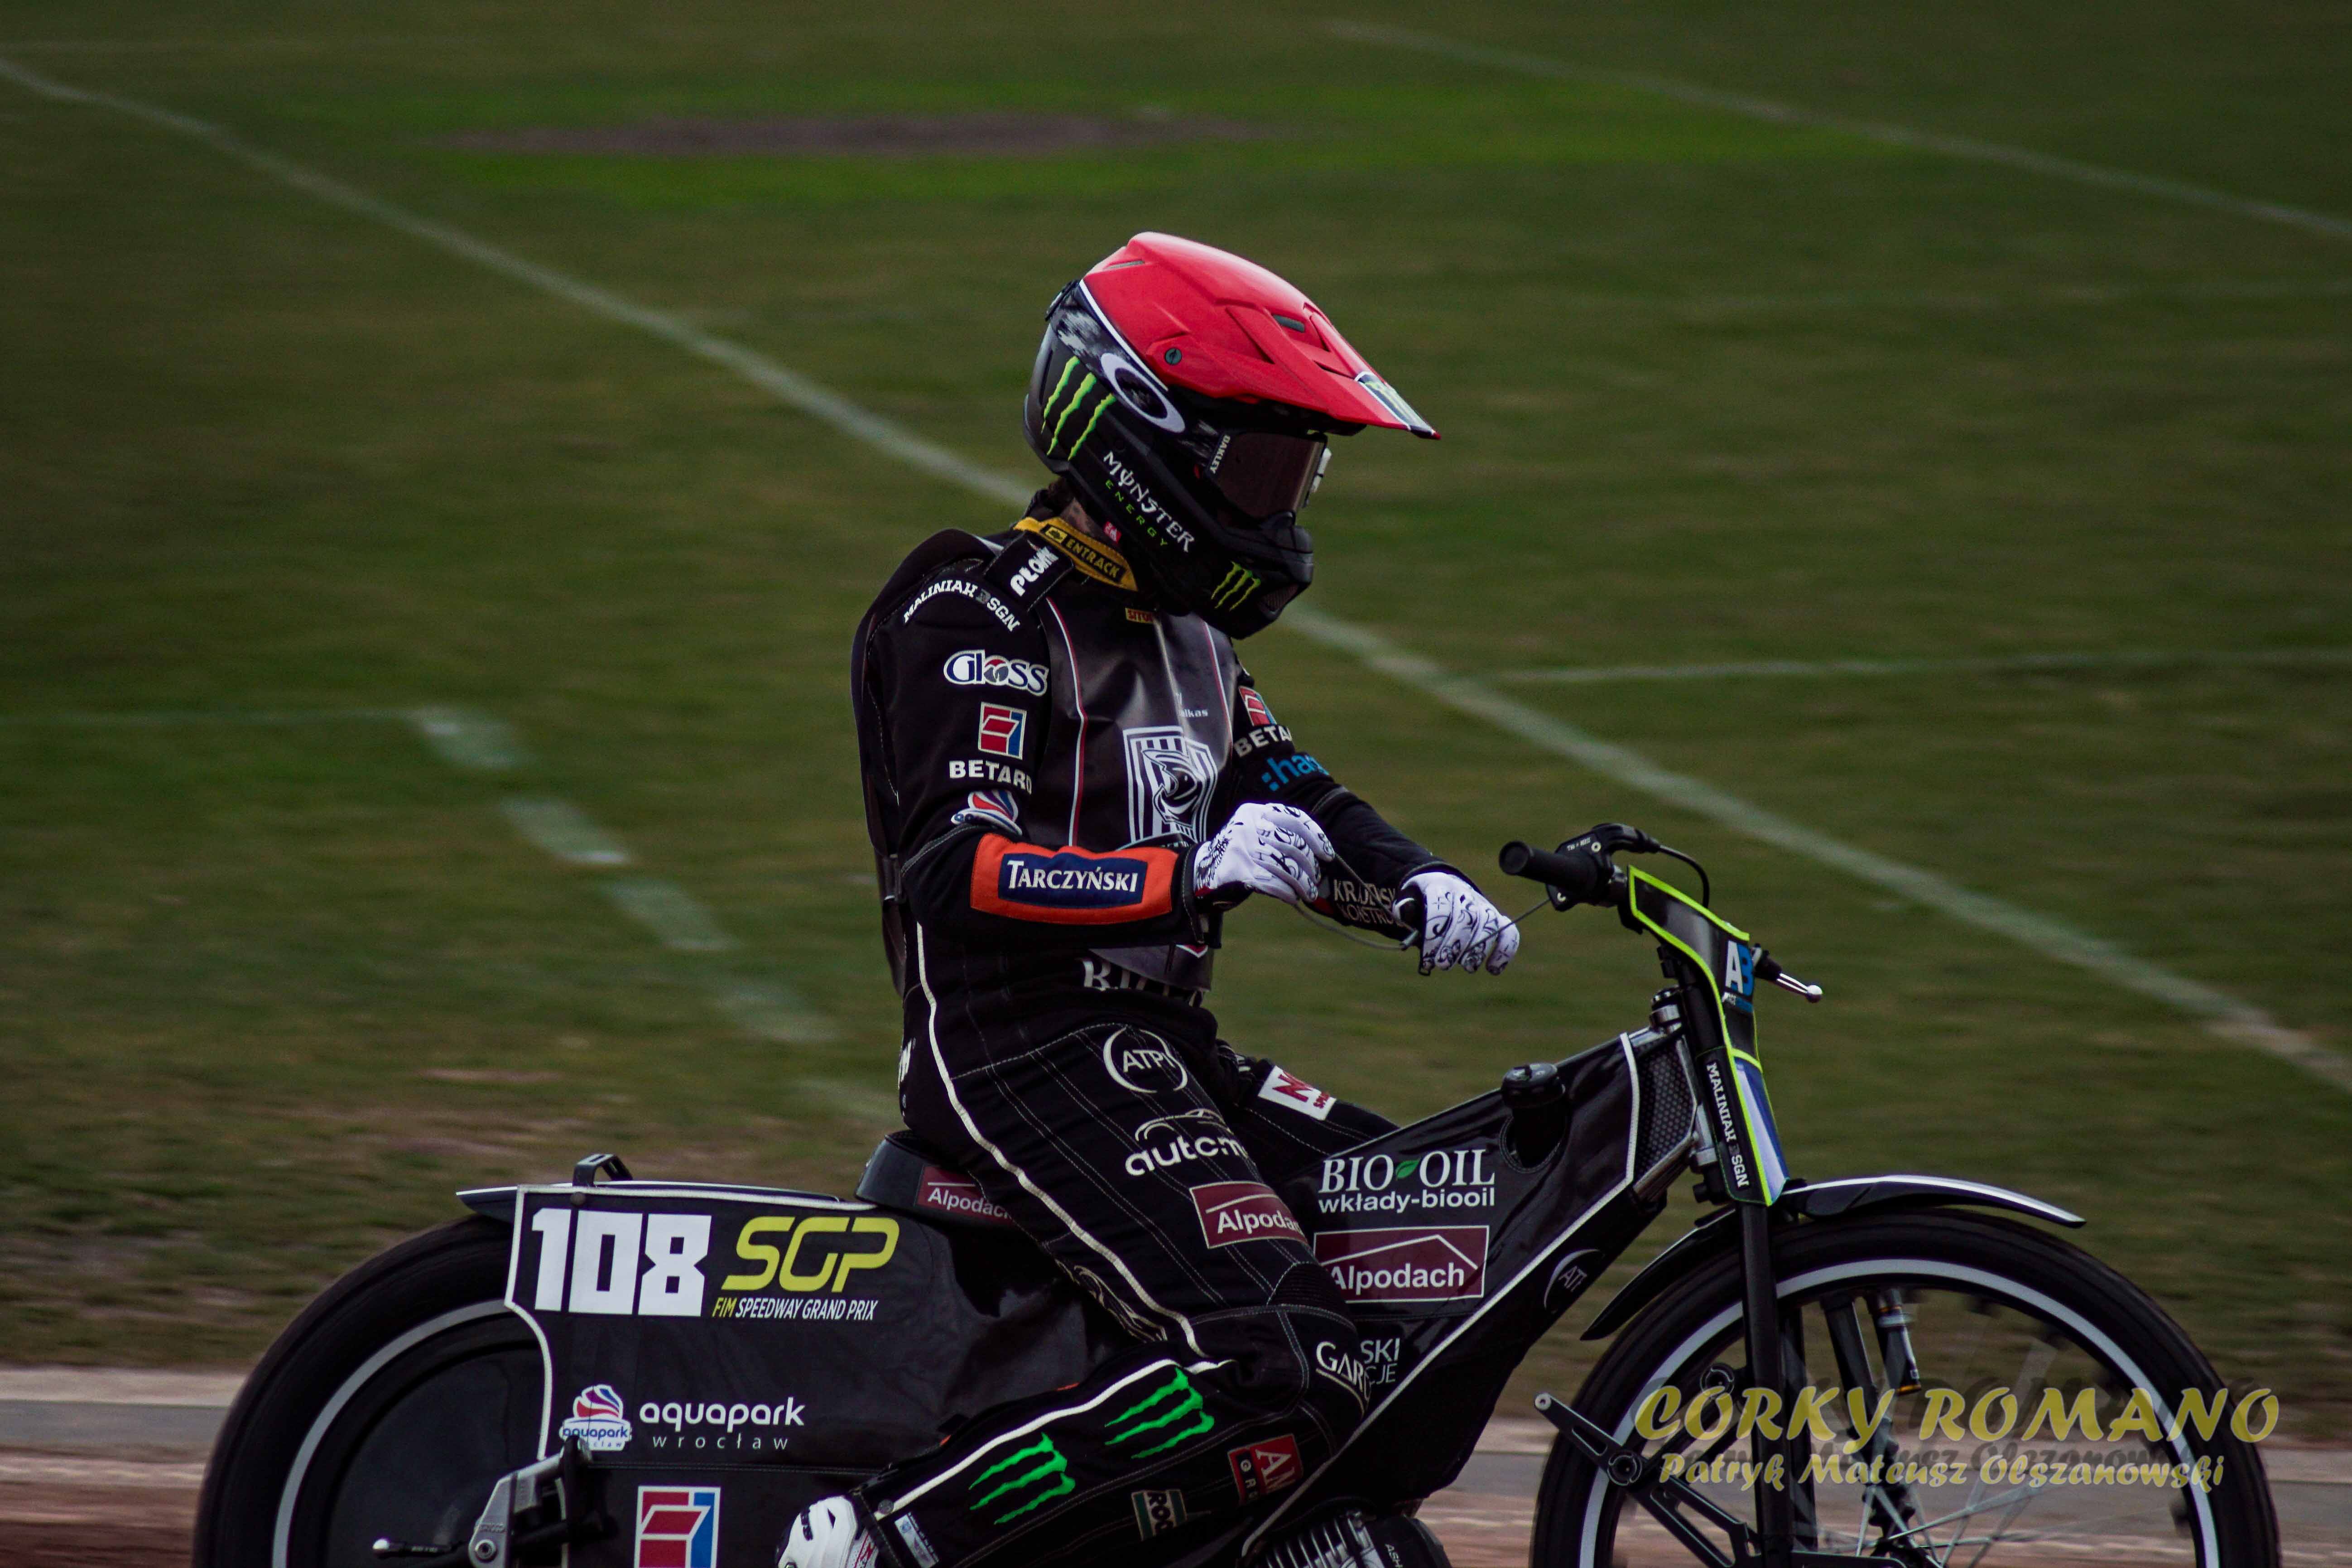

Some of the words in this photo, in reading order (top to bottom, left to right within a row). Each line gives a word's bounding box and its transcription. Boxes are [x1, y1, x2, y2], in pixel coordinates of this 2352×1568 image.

[1210, 434, 1231, 474] OAKLEY
[1103, 450, 1195, 553] MONSTER
[1105, 478, 1169, 546] ENERGY
[1007, 860, 1138, 892] TARCZYŃSKI
[1318, 1154, 1394, 1193] BIO
[1419, 1149, 1495, 1188] OIL
[1318, 1187, 1495, 1214] wkłady-biooil
[532, 1207, 712, 1318] 108
[721, 1215, 900, 1293] SGP
[1331, 1262, 1465, 1296] Alpodach
[712, 1297, 738, 1318] FIM
[735, 1297, 804, 1319] SPEEDWAY
[801, 1299, 847, 1320] GRAND
[845, 1299, 879, 1321] PRIX
[639, 1396, 806, 1433] aquapark
